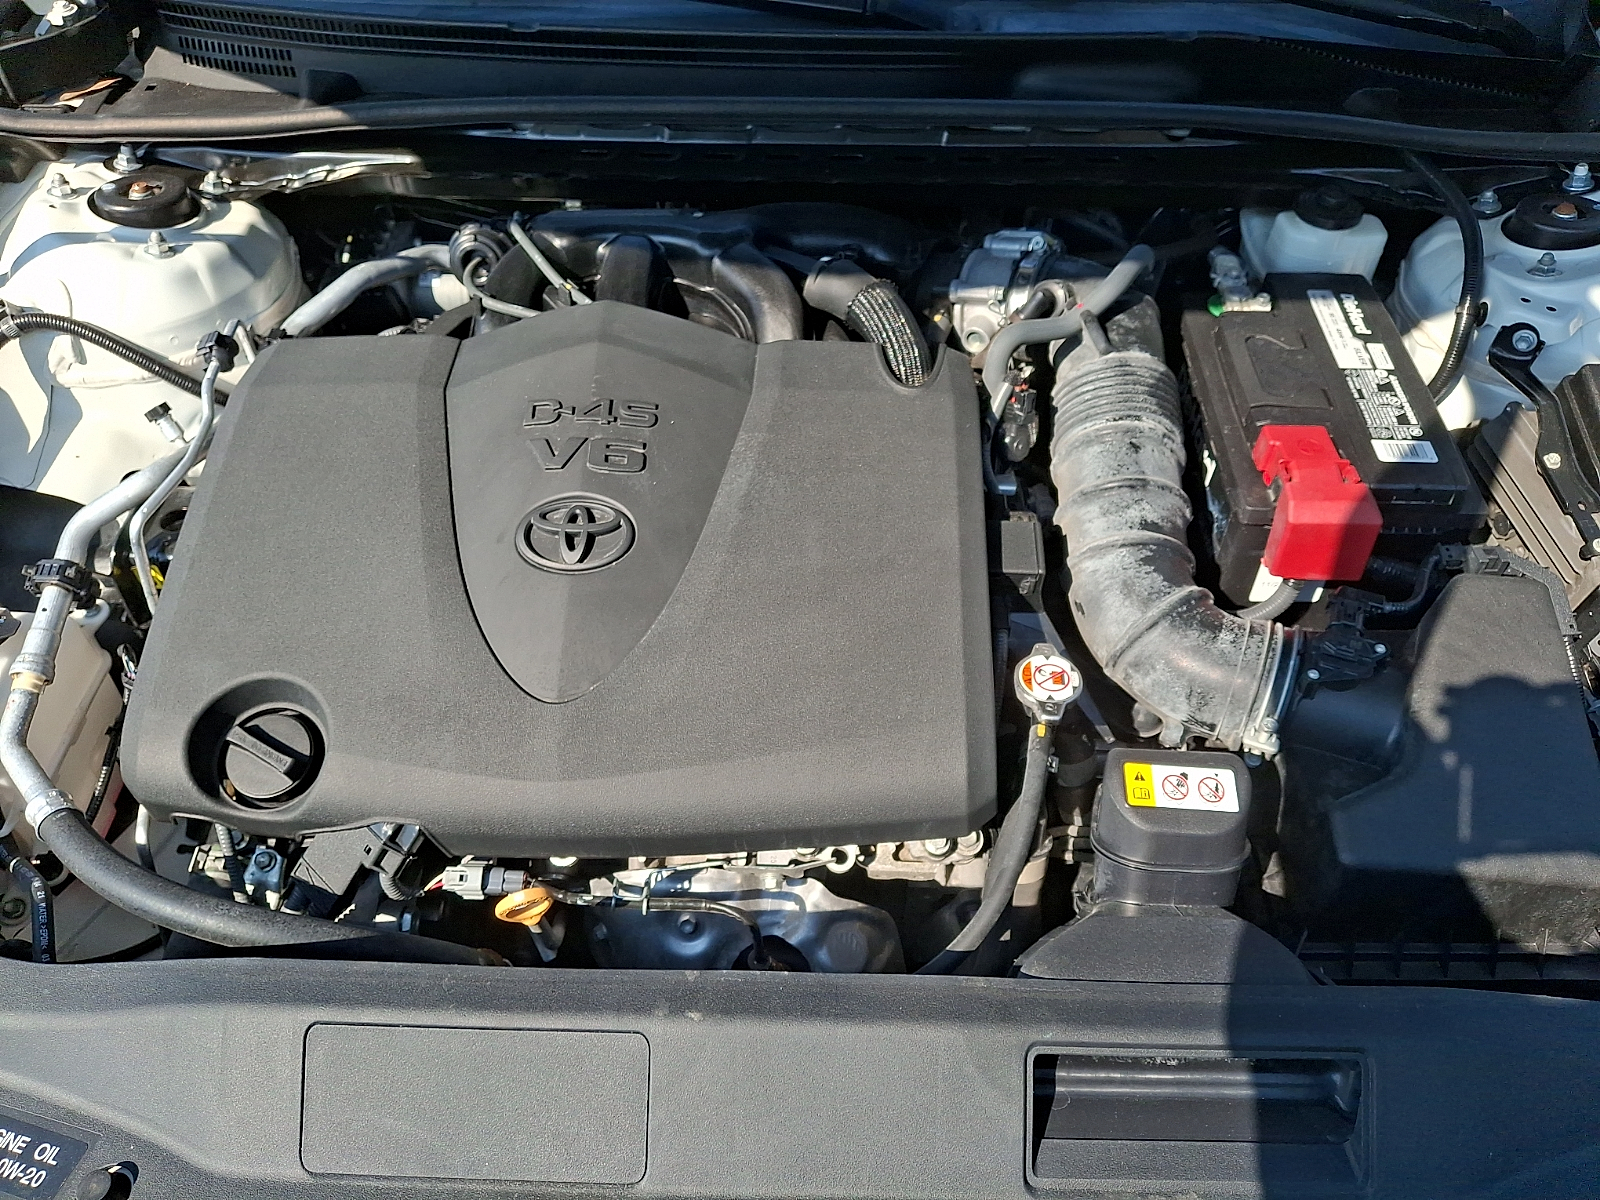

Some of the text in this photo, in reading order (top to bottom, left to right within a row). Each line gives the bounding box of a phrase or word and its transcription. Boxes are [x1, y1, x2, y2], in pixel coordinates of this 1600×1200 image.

[1340, 293, 1372, 335] DieHard
[523, 398, 660, 429] D-4S
[528, 438, 648, 474] V6
[38, 902, 48, 925] WATER
[34, 1143, 61, 1166] OIL
[0, 1158, 47, 1188] 0W-20
